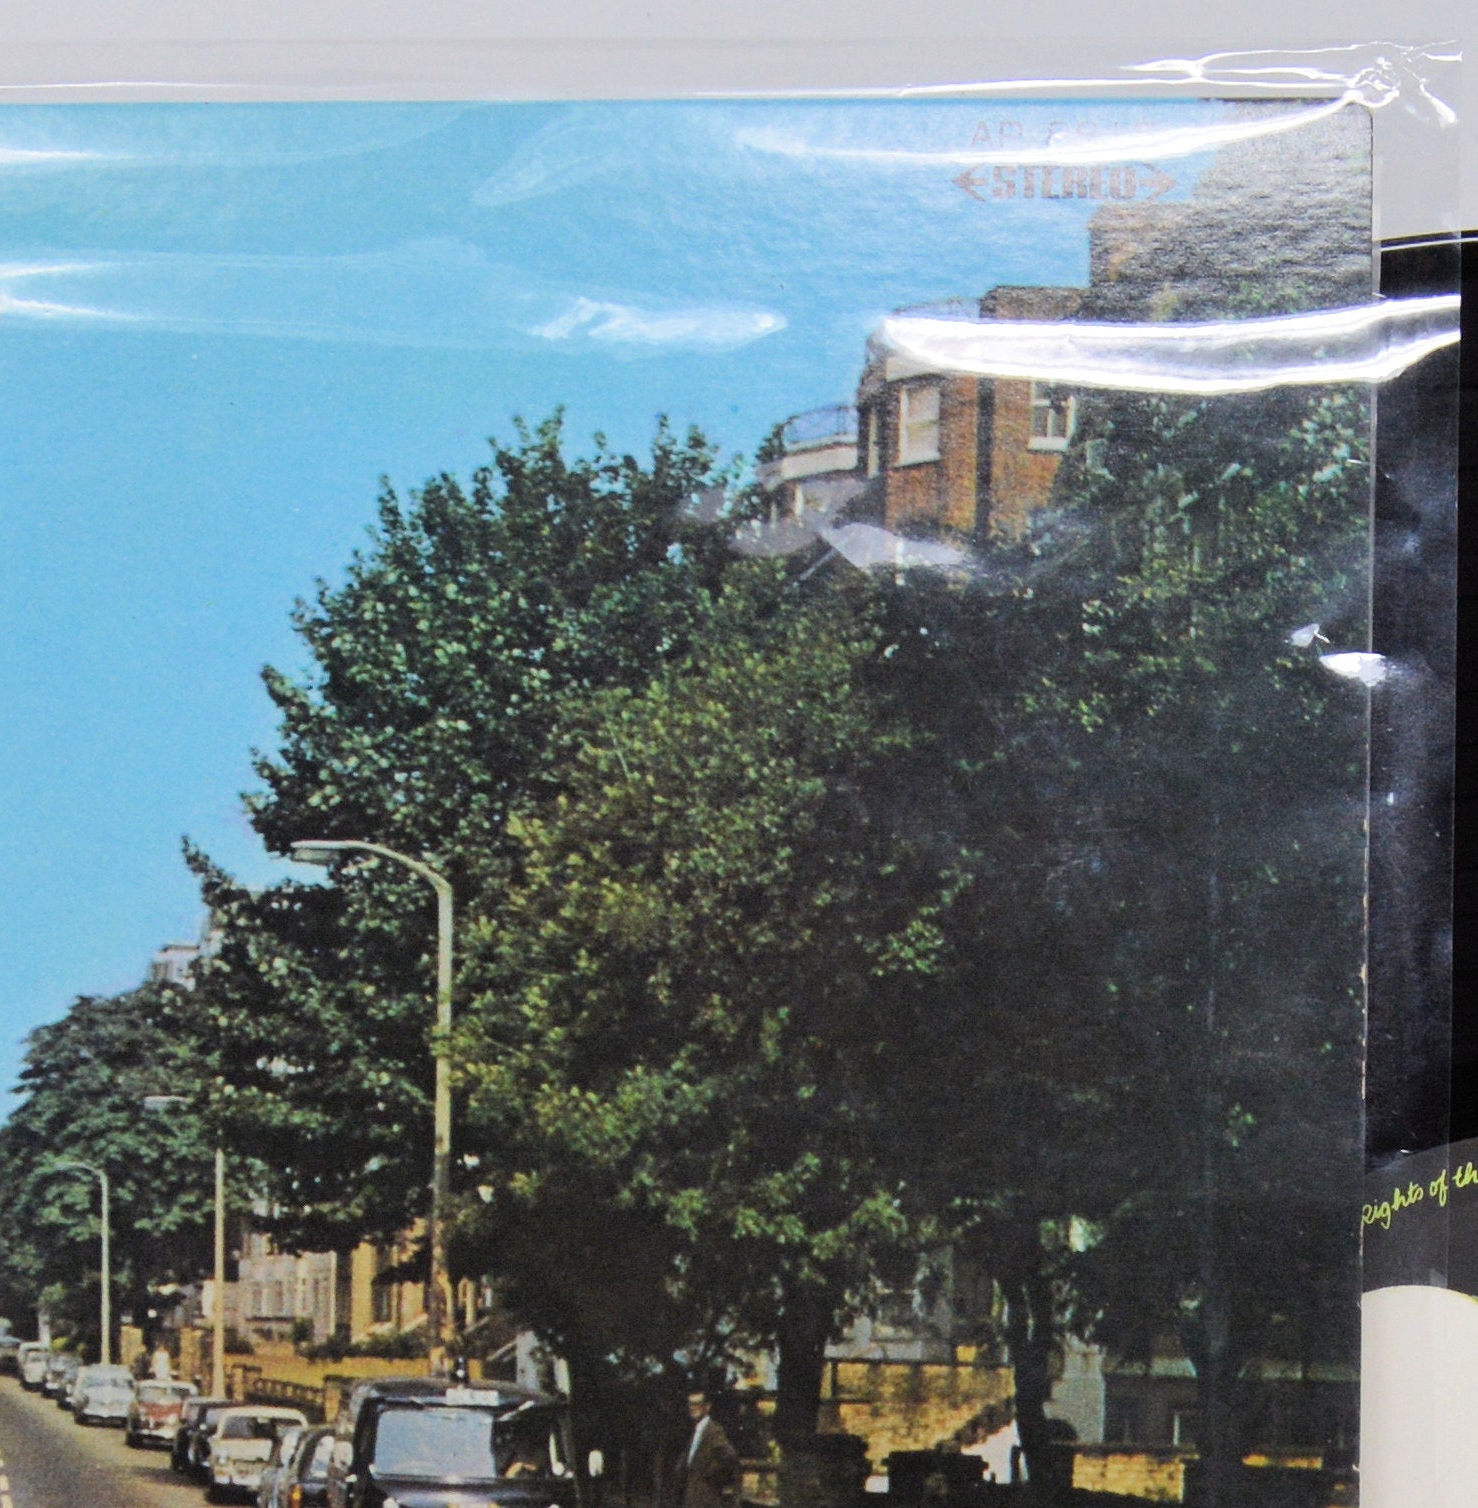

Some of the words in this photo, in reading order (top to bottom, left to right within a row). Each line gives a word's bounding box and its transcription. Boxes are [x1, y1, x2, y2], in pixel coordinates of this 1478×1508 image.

[991, 165, 1138, 199] STEREO
[1361, 1182, 1423, 1230] Rights
[1429, 1169, 1448, 1207] of
